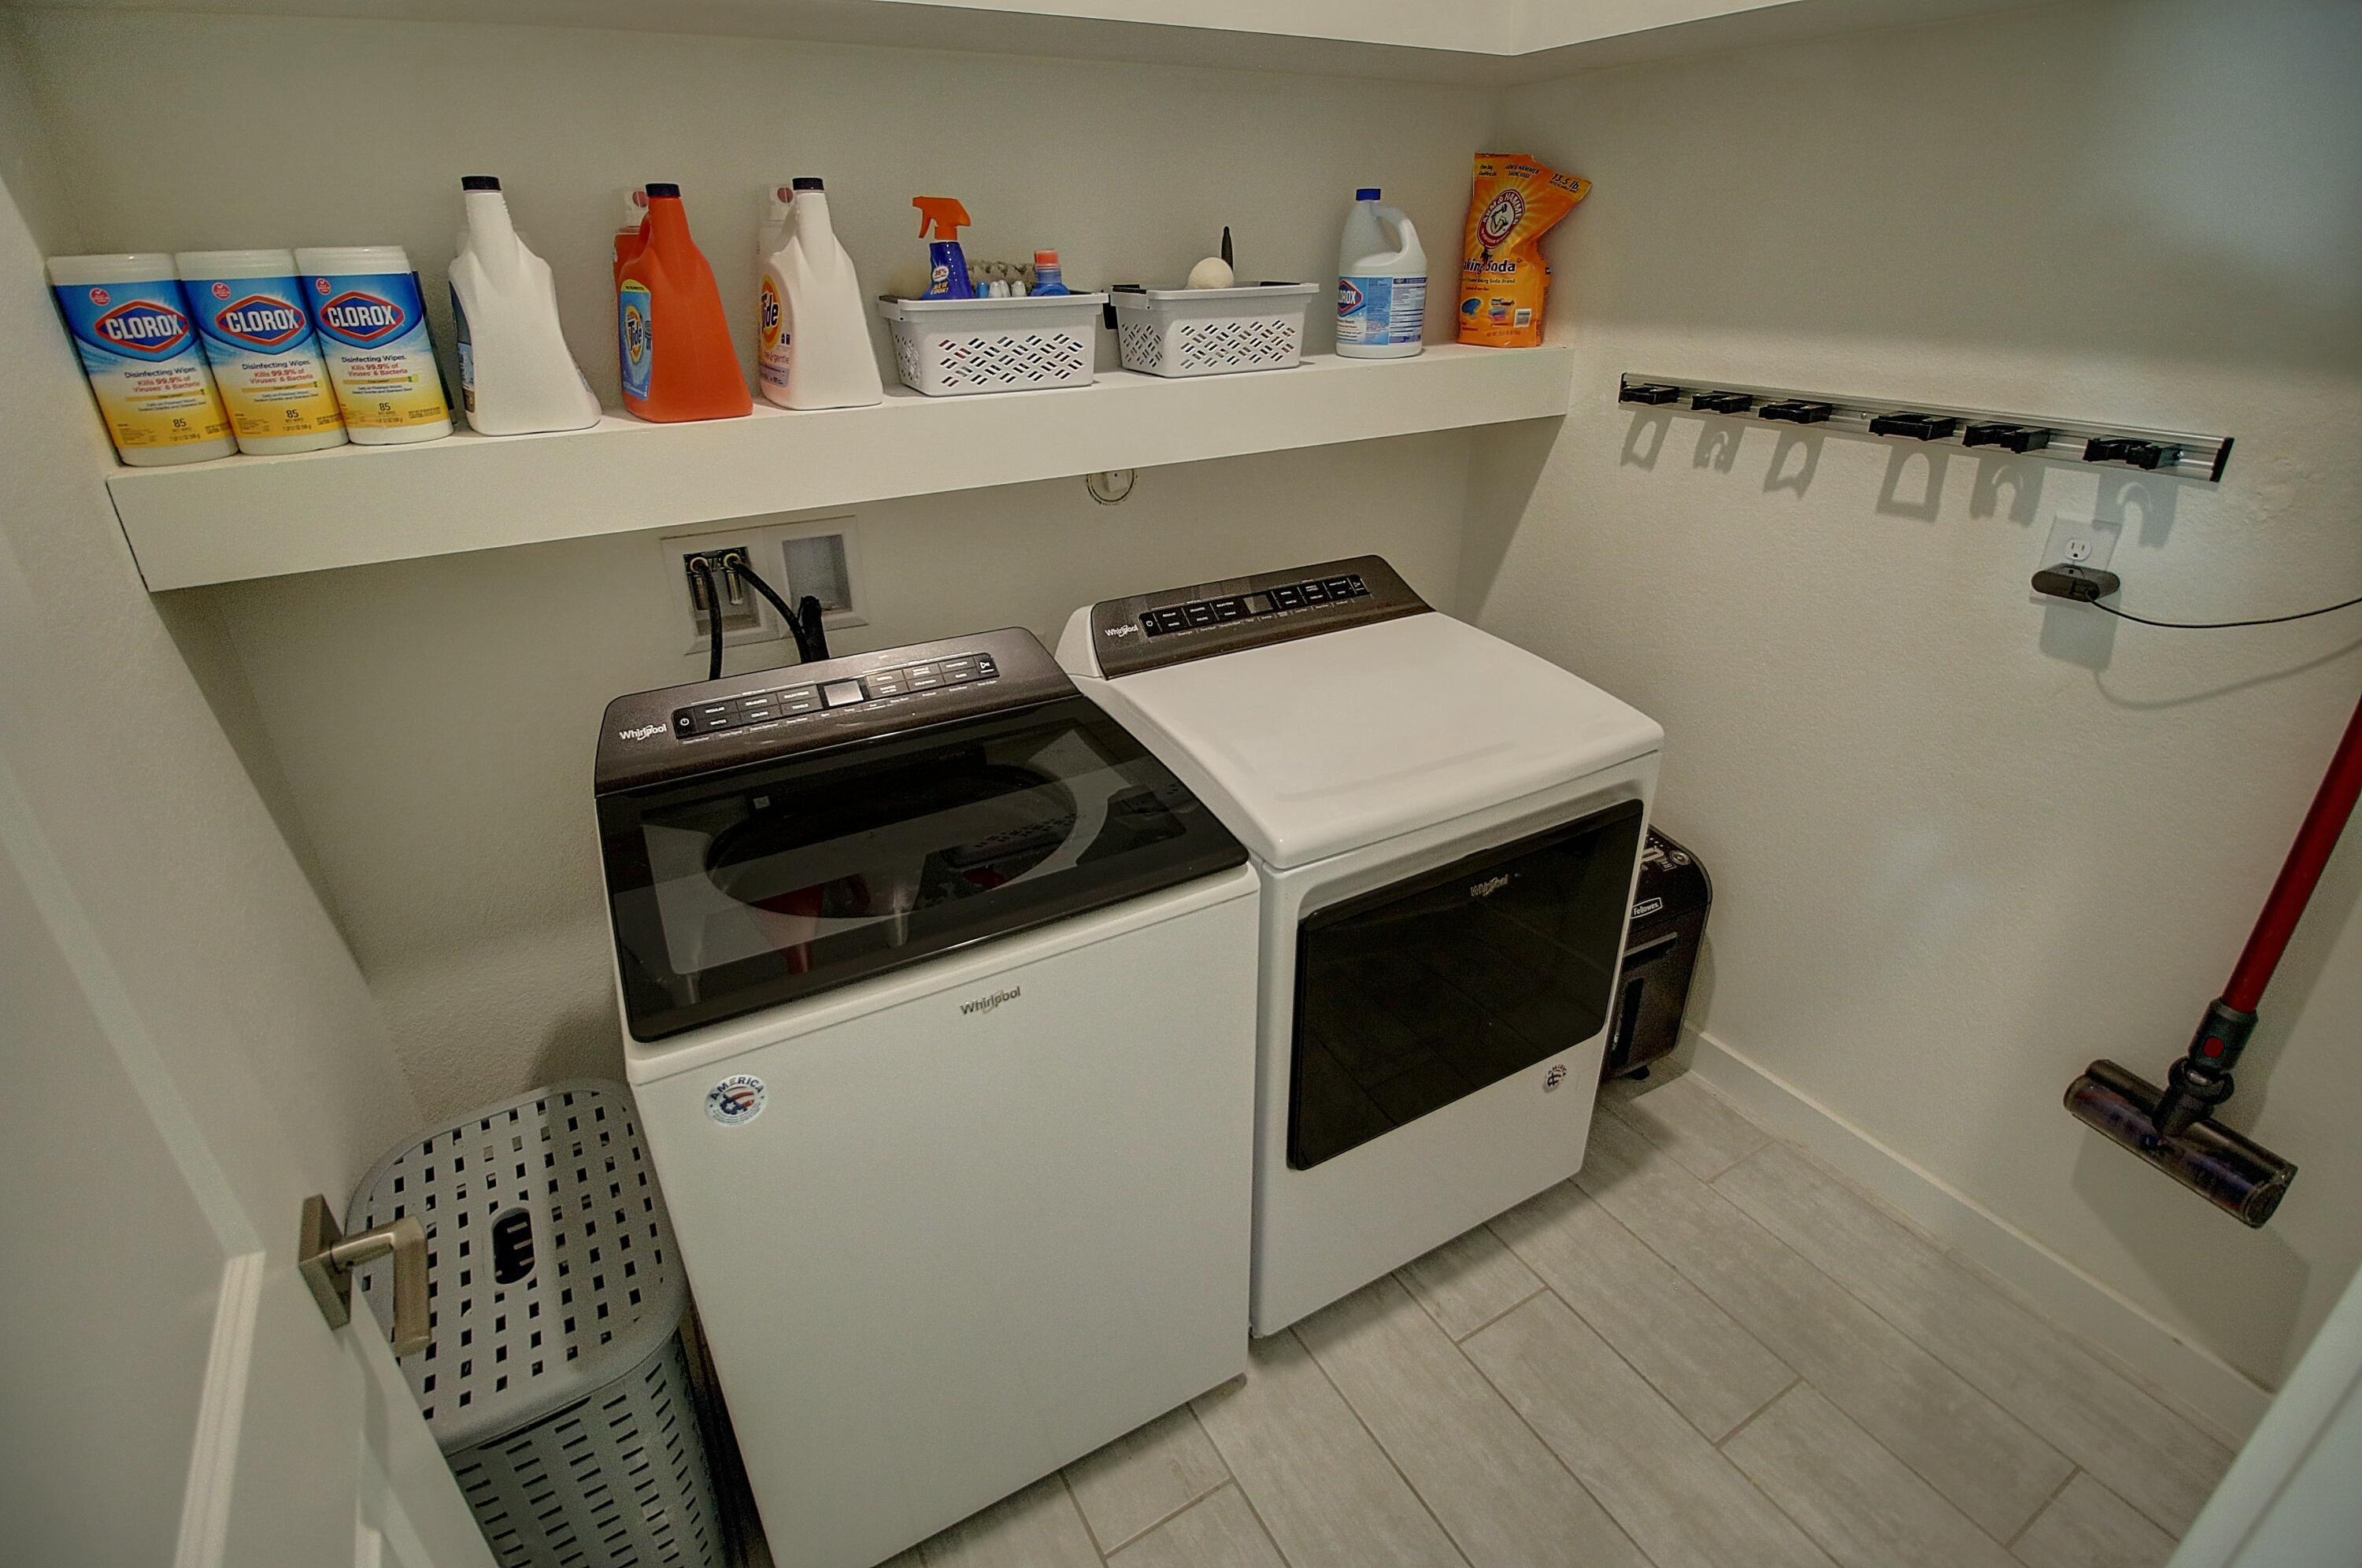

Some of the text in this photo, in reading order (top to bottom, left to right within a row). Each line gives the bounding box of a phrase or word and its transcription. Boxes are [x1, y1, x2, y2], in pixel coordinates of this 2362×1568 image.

[1551, 174, 1569, 186] 13.5
[1483, 202, 1498, 223] ARM
[1505, 193, 1523, 224] HAMMER
[1485, 259, 1516, 274] Soda
[225, 309, 300, 334] CLOROX
[327, 305, 396, 327] CLOROX
[761, 292, 779, 334] Tide
[105, 314, 183, 341] CLOROX
[628, 318, 642, 351] Tide
[124, 369, 172, 378] Disinfecting
[286, 409, 299, 419] 85
[379, 402, 391, 411] 85
[172, 418, 187, 428] 85
[1104, 624, 1138, 637] Whirlpool
[619, 723, 668, 740] Whirlpool
[1470, 874, 1509, 897] Whirlpool
[1633, 901, 1660, 916] Fellowes
[960, 986, 1021, 1015] Whirlpool
[710, 1076, 765, 1100] AMERICA
